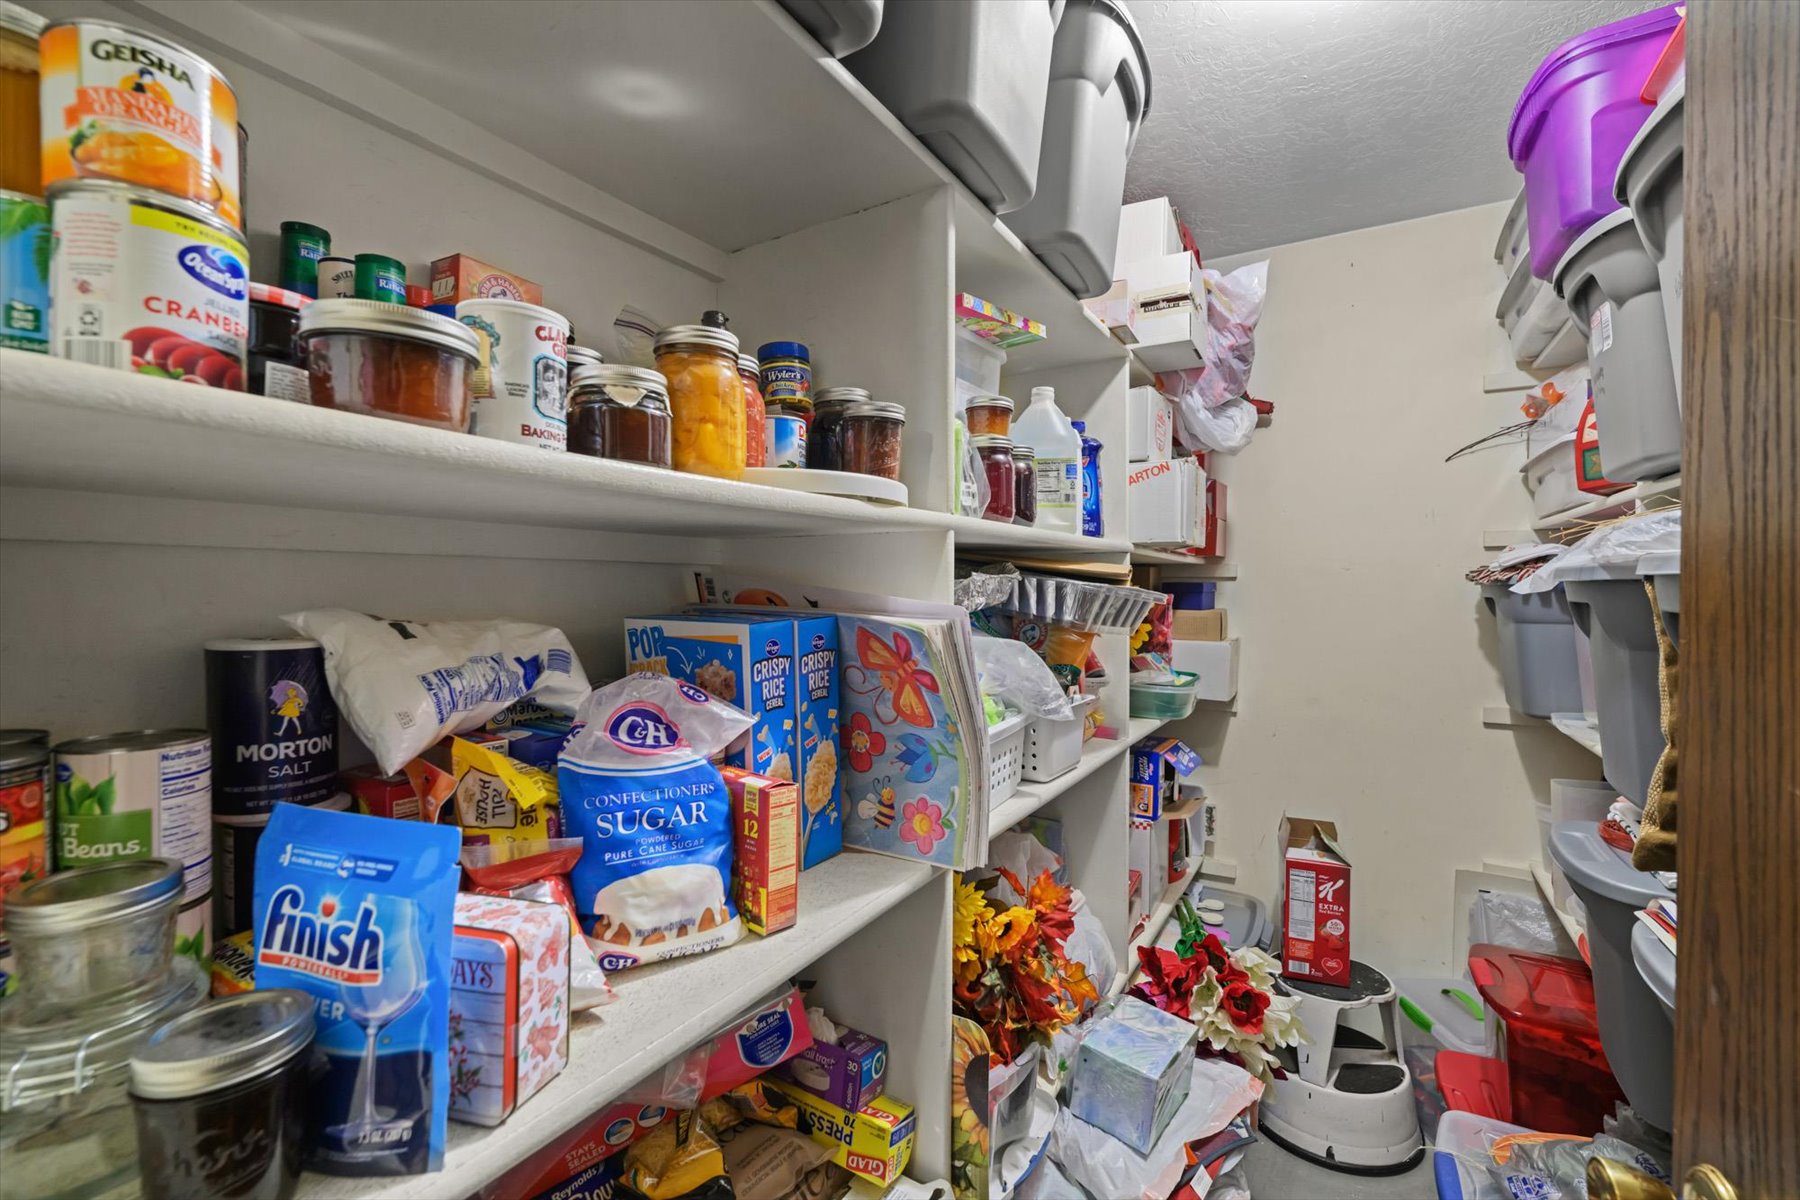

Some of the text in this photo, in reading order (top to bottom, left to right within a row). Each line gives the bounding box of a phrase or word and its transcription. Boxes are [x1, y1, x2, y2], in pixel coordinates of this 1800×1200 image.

[91, 39, 196, 93] GEISHA
[767, 369, 802, 381] Wyler's
[1128, 461, 1171, 487] ARTON
[627, 625, 665, 661] POP
[753, 657, 791, 682] CRISPY
[801, 650, 836, 675] CRISPY
[762, 677, 786, 701] RICE
[808, 669, 830, 691] RICE
[765, 698, 784, 711] CEREAL
[811, 690, 829, 701] CEREAL
[617, 715, 675, 746] C&H
[161, 747, 201, 762] Nutrition
[236, 733, 333, 763] MORTON
[267, 760, 313, 778] SALT
[162, 783, 196, 796] Calories
[475, 778, 492, 825] HOUSE
[584, 782, 716, 809] CONFECTIONERS
[596, 801, 709, 839] SUGAR
[743, 818, 759, 840] 12
[63, 837, 142, 859] Beans
[604, 838, 705, 862] PURE CANE SUGAR
[635, 833, 681, 846] POWDERED
[1318, 902, 1345, 912] EXTRA
[262, 885, 382, 972] finish
[281, 957, 347, 980] POWERBALL
[451, 959, 494, 989] AYS
[846, 1060, 858, 1072] 30
[809, 1113, 853, 1147] PRESS
[843, 1115, 856, 1129] 70
[565, 1140, 596, 1161] STAYS
[567, 1145, 606, 1170] SEALED
[848, 1155, 885, 1177] GLAD
[551, 1168, 598, 1200] Reynolds
